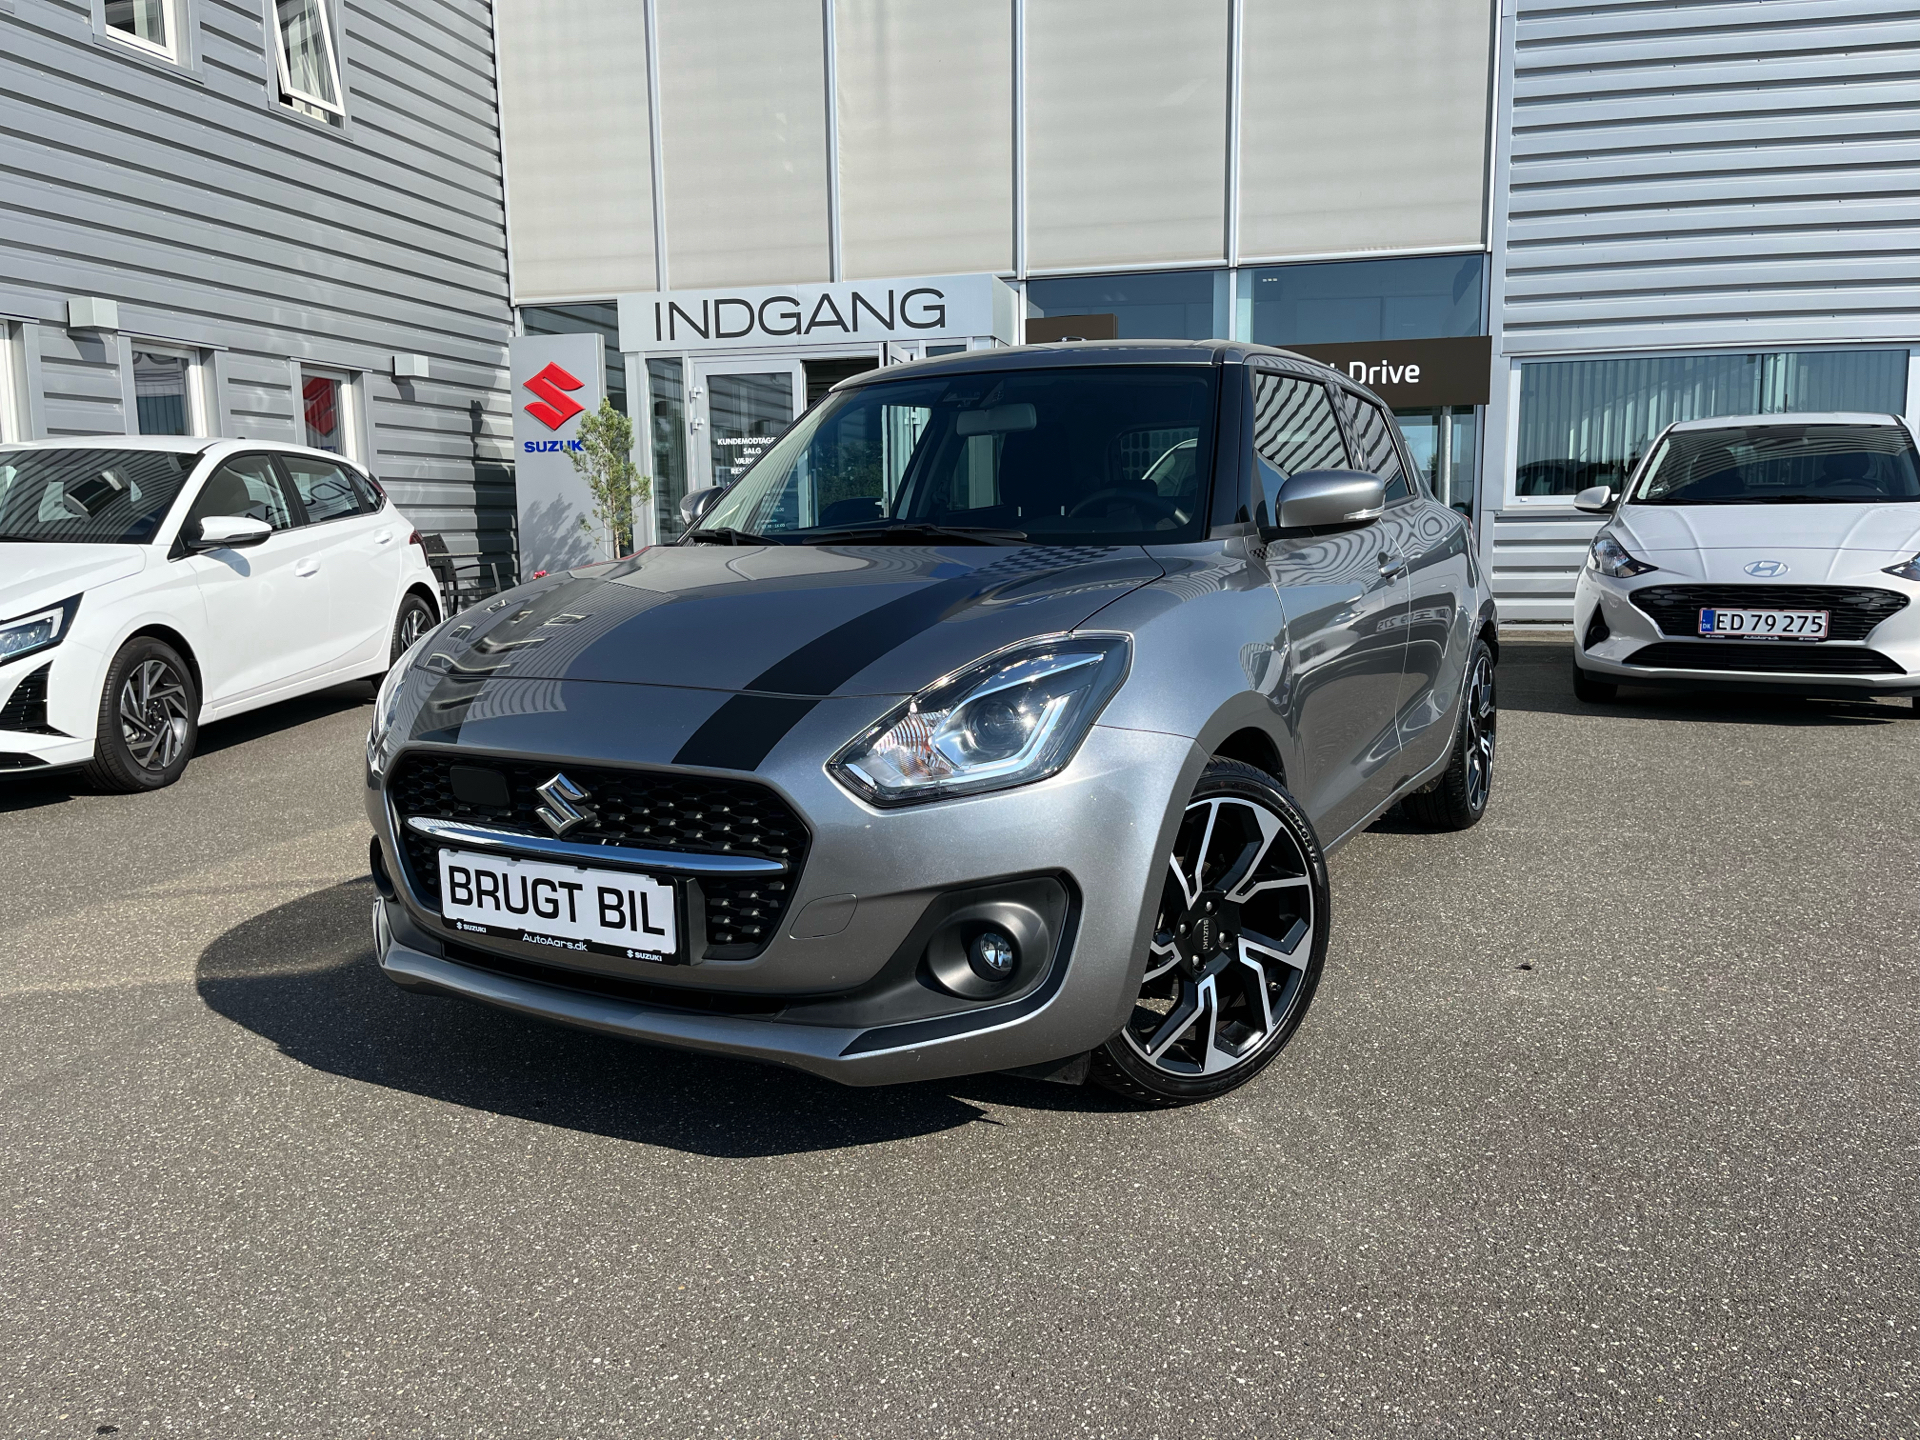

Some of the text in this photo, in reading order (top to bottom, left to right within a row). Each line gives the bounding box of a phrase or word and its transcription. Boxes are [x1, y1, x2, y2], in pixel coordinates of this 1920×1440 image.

[655, 288, 946, 342] INDGANG
[1349, 359, 1420, 385] Drive
[524, 440, 585, 453] SUZUK
[1716, 613, 1745, 631] ED
[1751, 613, 1777, 632] 79
[1782, 615, 1823, 633] 275
[448, 865, 665, 936] BRUGT BIL
[463, 923, 487, 934] SUZUKI
[522, 933, 588, 952] AutoAars.dk
[634, 951, 663, 962] SUZUKI
